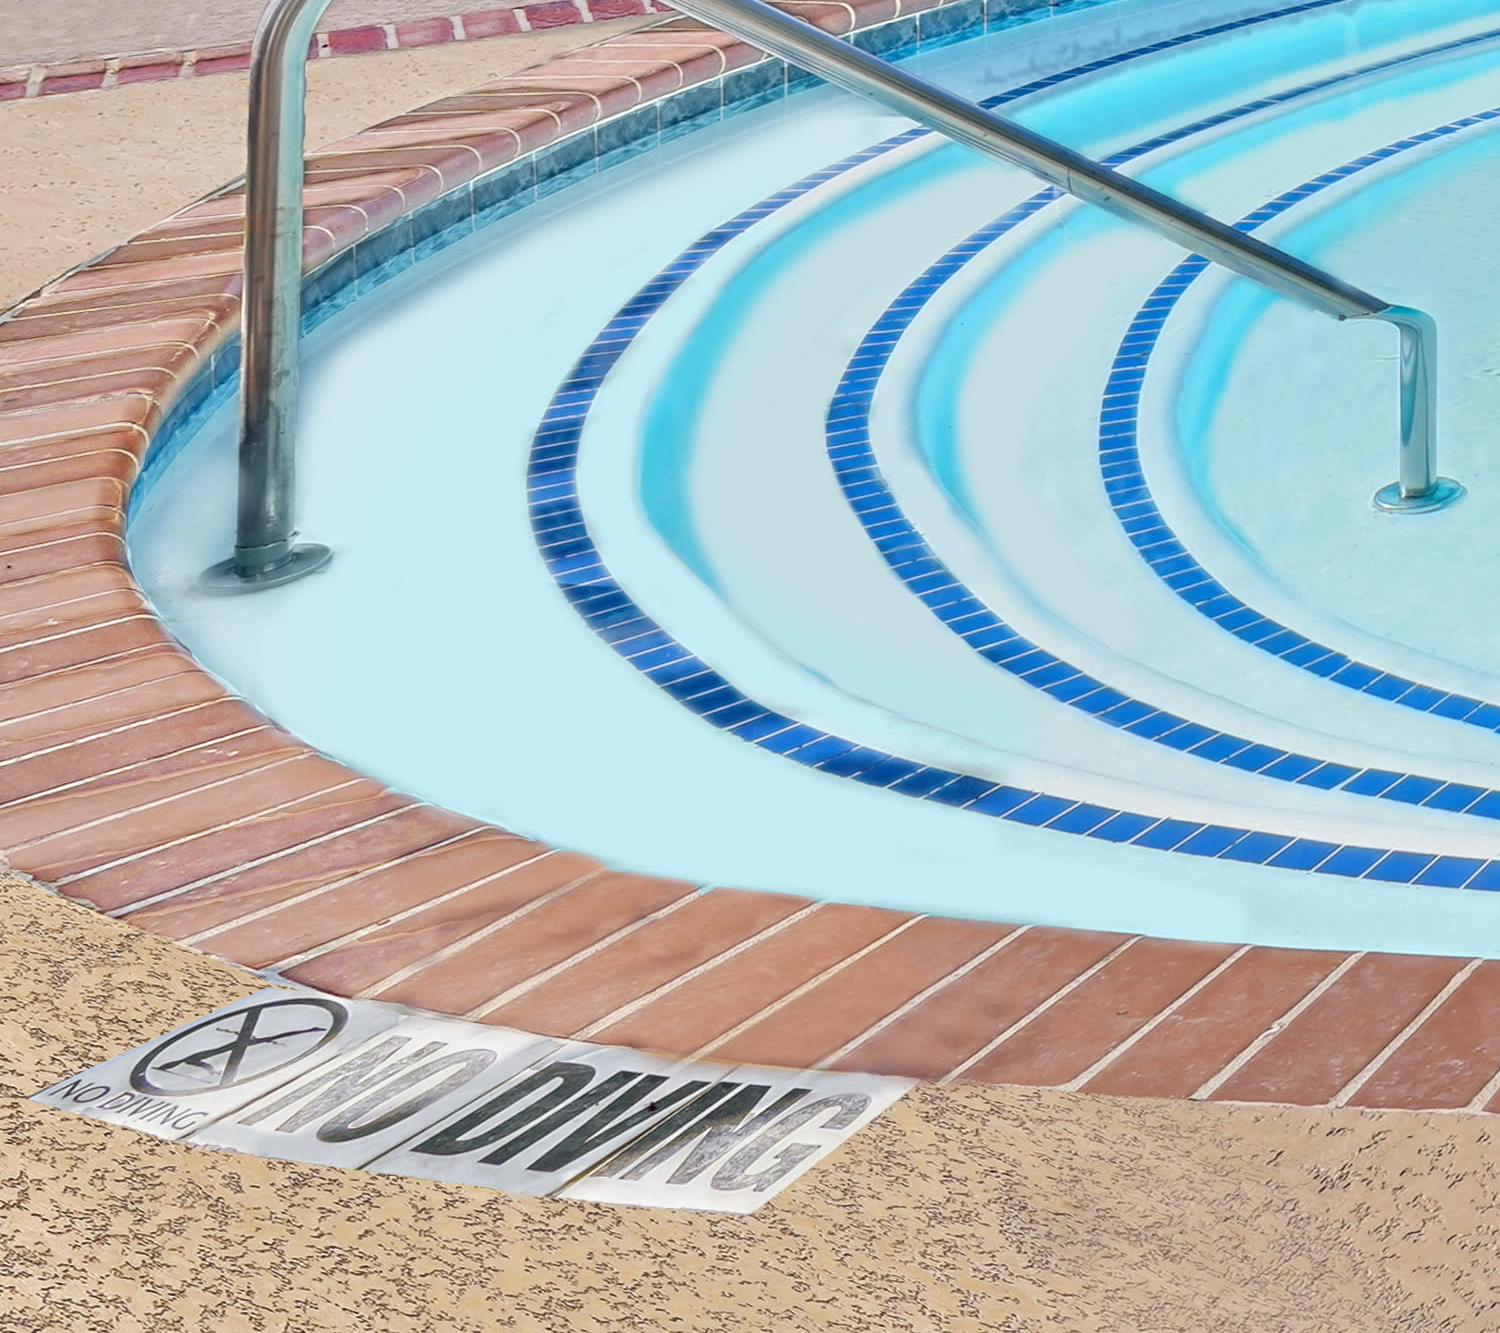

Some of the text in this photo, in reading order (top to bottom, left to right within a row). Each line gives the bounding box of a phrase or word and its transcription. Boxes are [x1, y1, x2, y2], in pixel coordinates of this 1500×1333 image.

[48, 1079, 209, 1130] NO DIVING
[239, 1036, 873, 1193] NO DIVING
